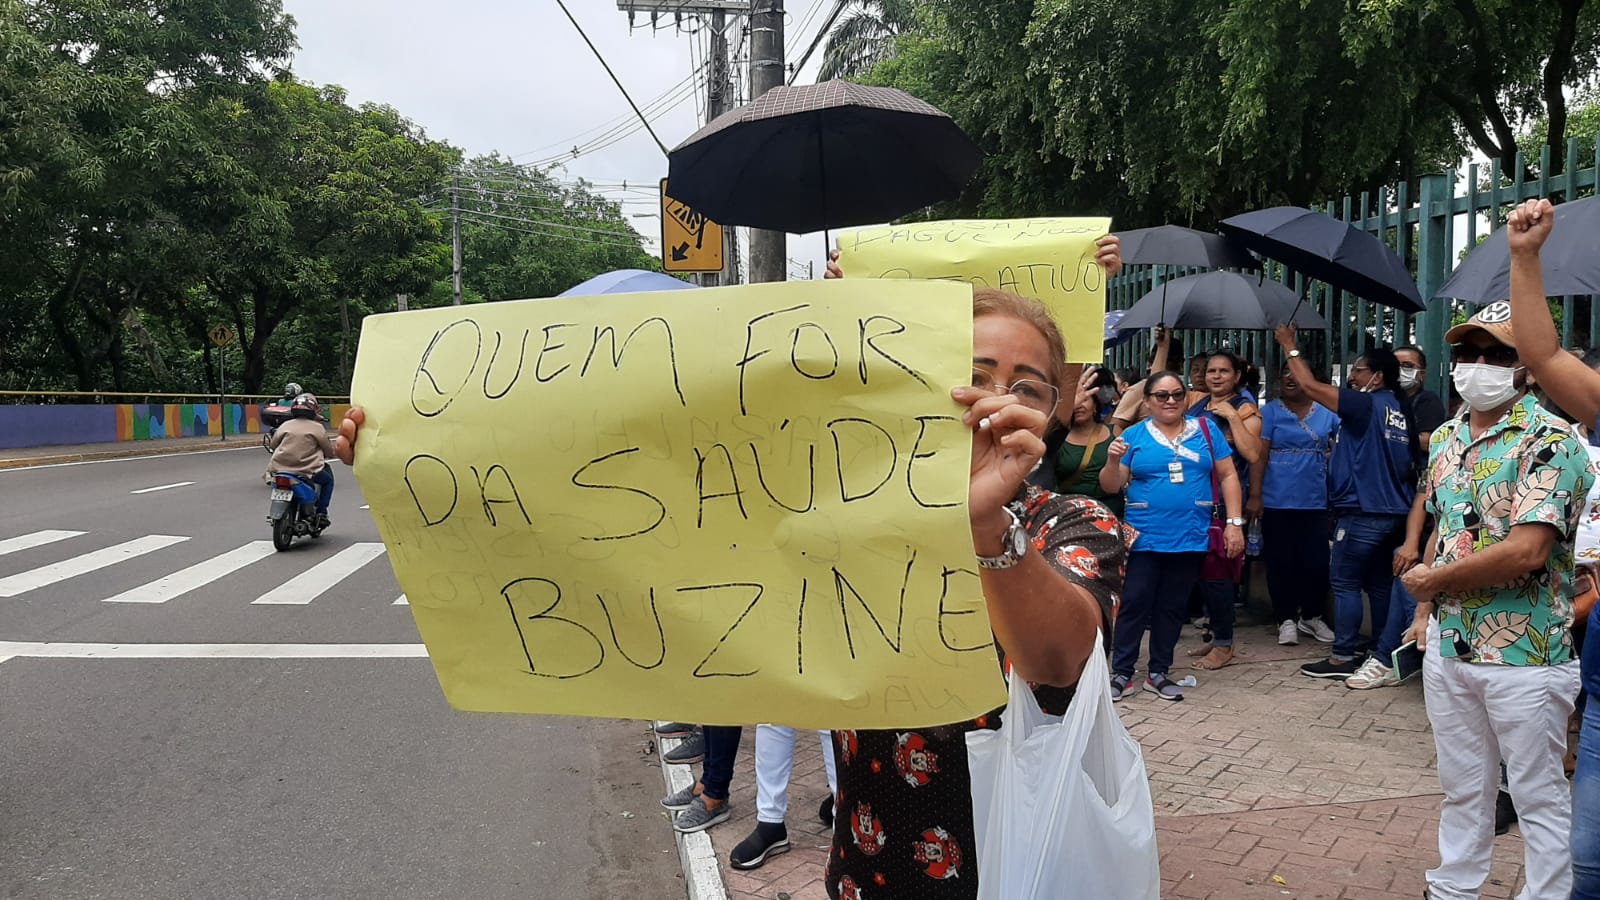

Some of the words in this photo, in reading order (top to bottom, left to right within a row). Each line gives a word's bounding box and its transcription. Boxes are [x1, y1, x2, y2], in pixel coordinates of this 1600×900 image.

[412, 318, 686, 417] QUEM
[737, 304, 932, 415] FOR
[404, 454, 531, 527] DA
[573, 417, 965, 540] SAÚDE
[501, 548, 994, 679] BUZINE
